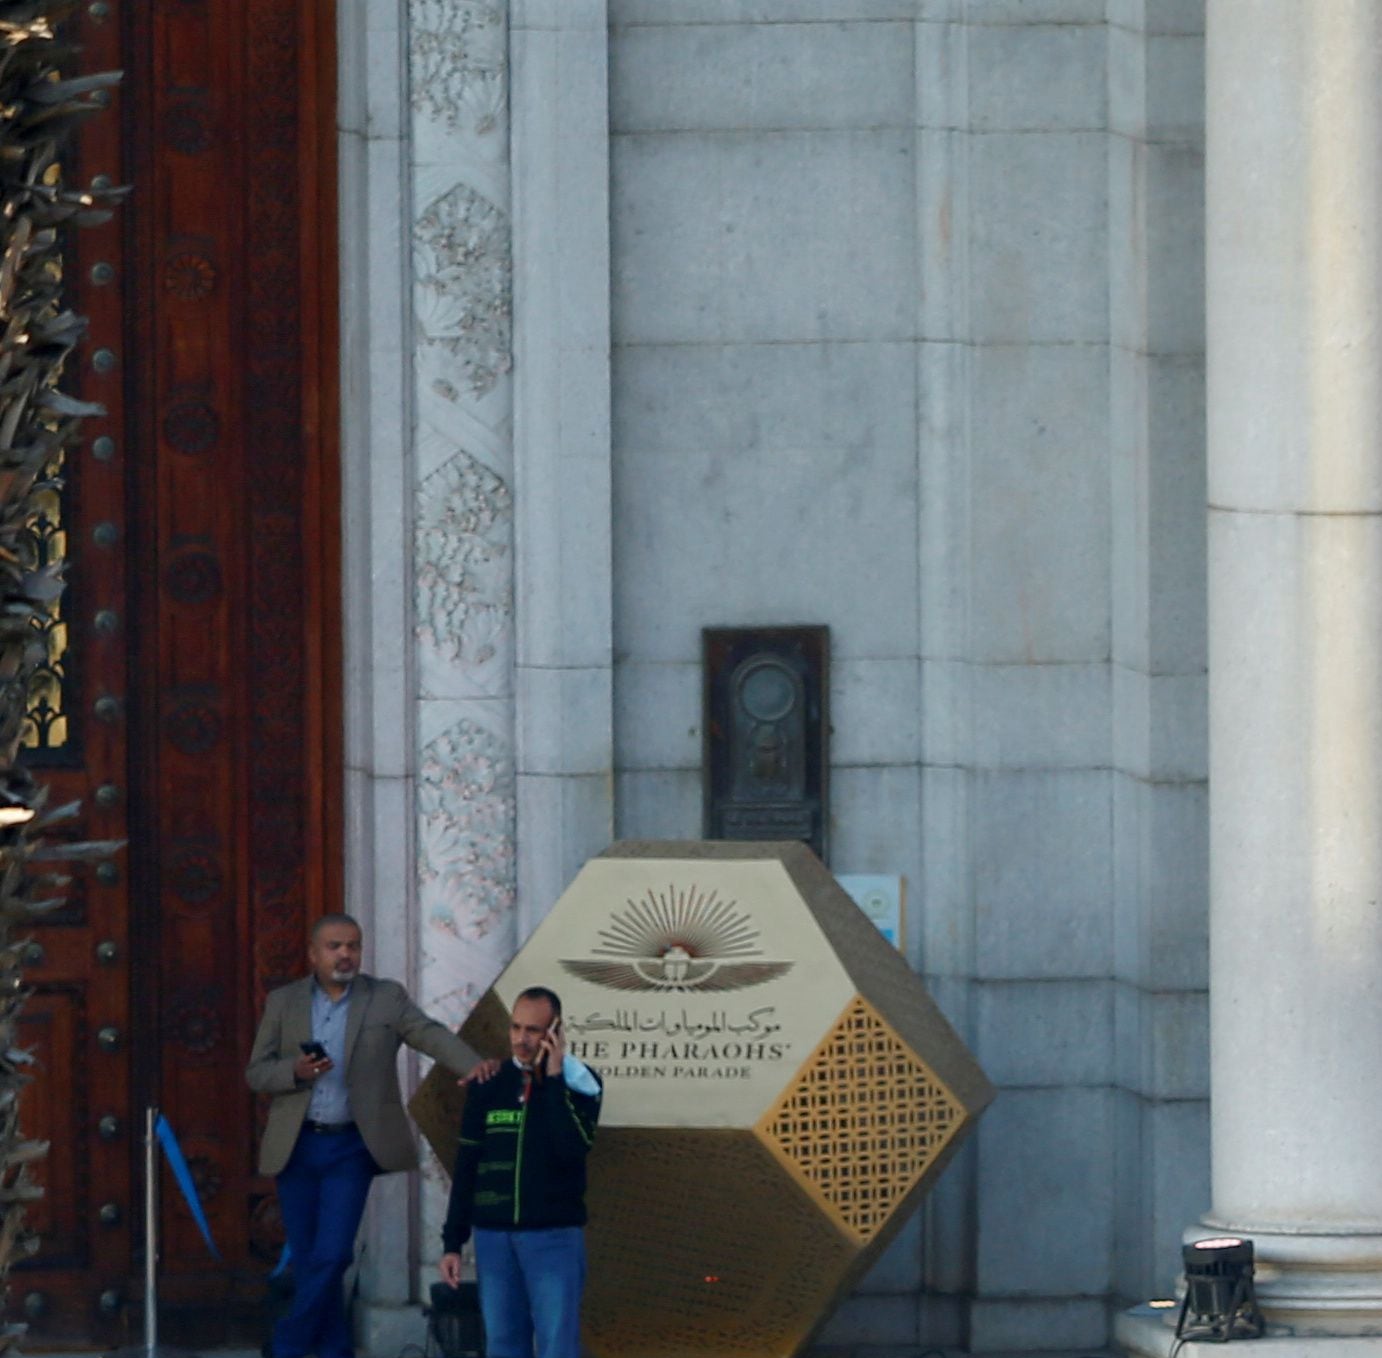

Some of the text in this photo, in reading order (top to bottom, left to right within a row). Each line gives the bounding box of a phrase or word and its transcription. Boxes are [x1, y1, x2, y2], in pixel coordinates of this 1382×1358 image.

[570, 1042, 609, 1058] HE
[599, 1066, 752, 1080] OLDEN PARADE
